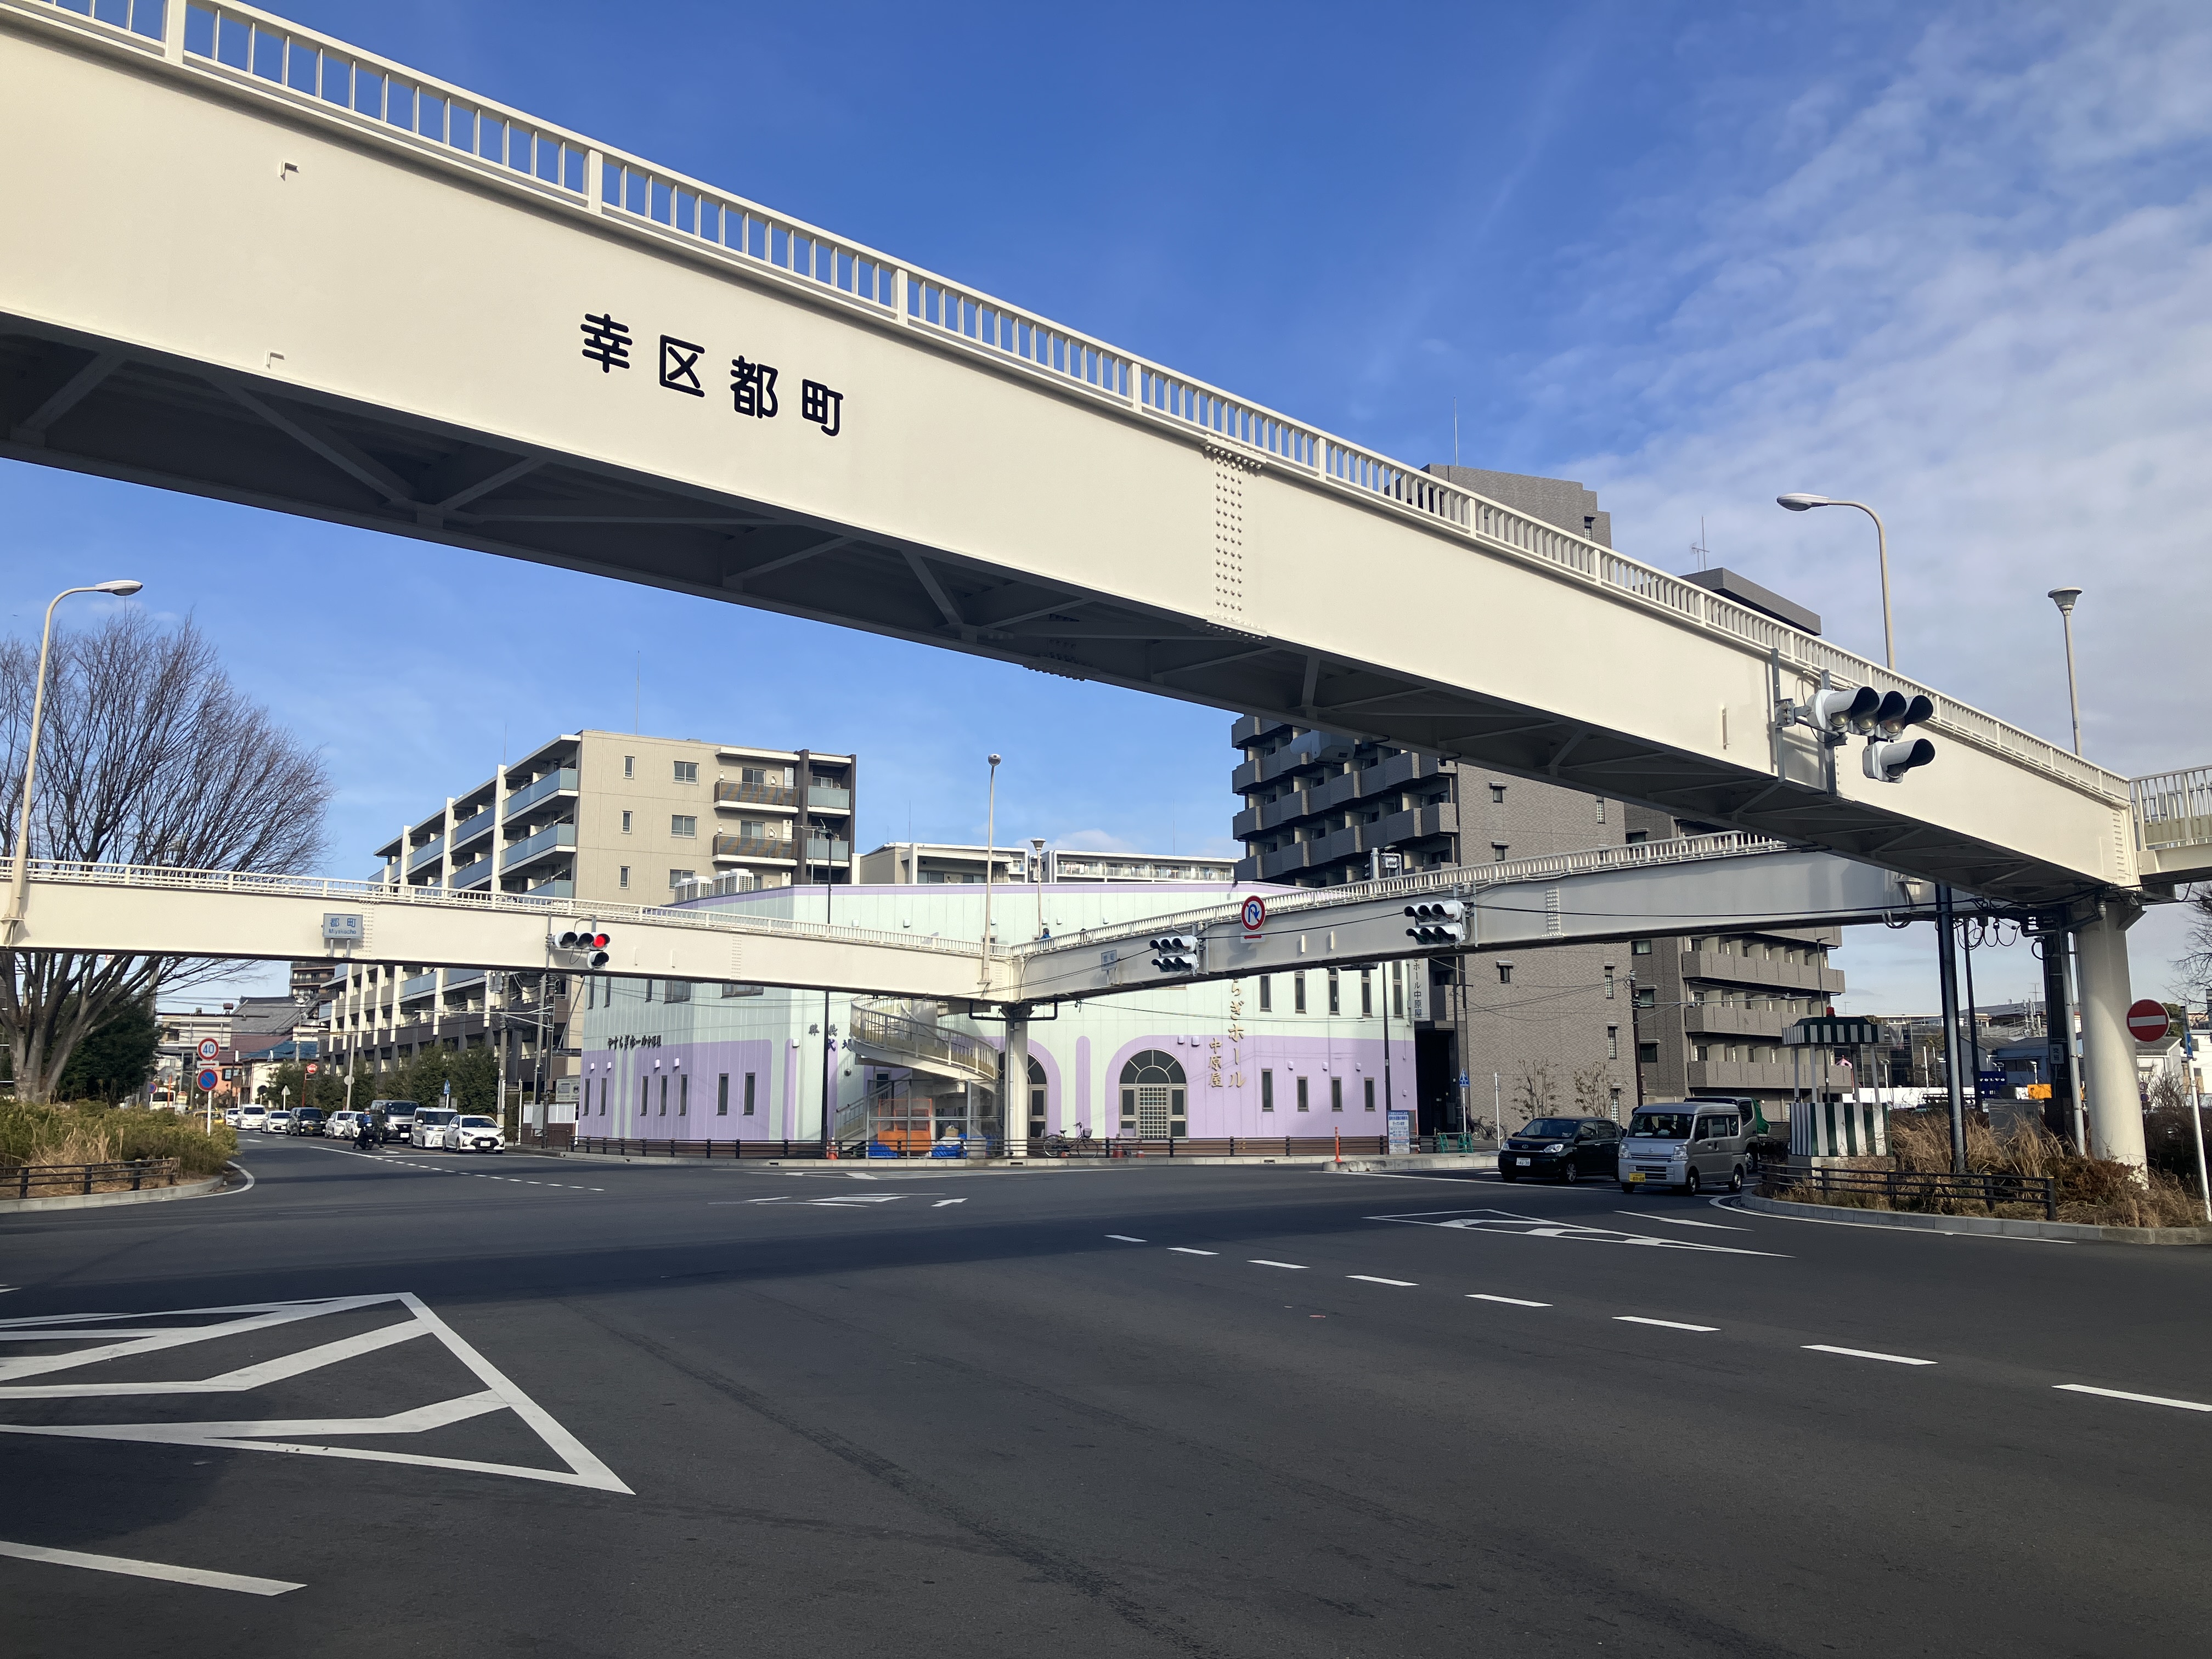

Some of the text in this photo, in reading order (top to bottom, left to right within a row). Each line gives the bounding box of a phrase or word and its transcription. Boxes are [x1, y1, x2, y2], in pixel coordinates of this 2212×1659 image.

[580, 313, 844, 437] 幸区都町
[330, 918, 357, 928] 都町
[1413, 959, 1422, 1018] ホール中原屋
[202, 1044, 215, 1054] 40
[1209, 1037, 1223, 1088] 中原屋
